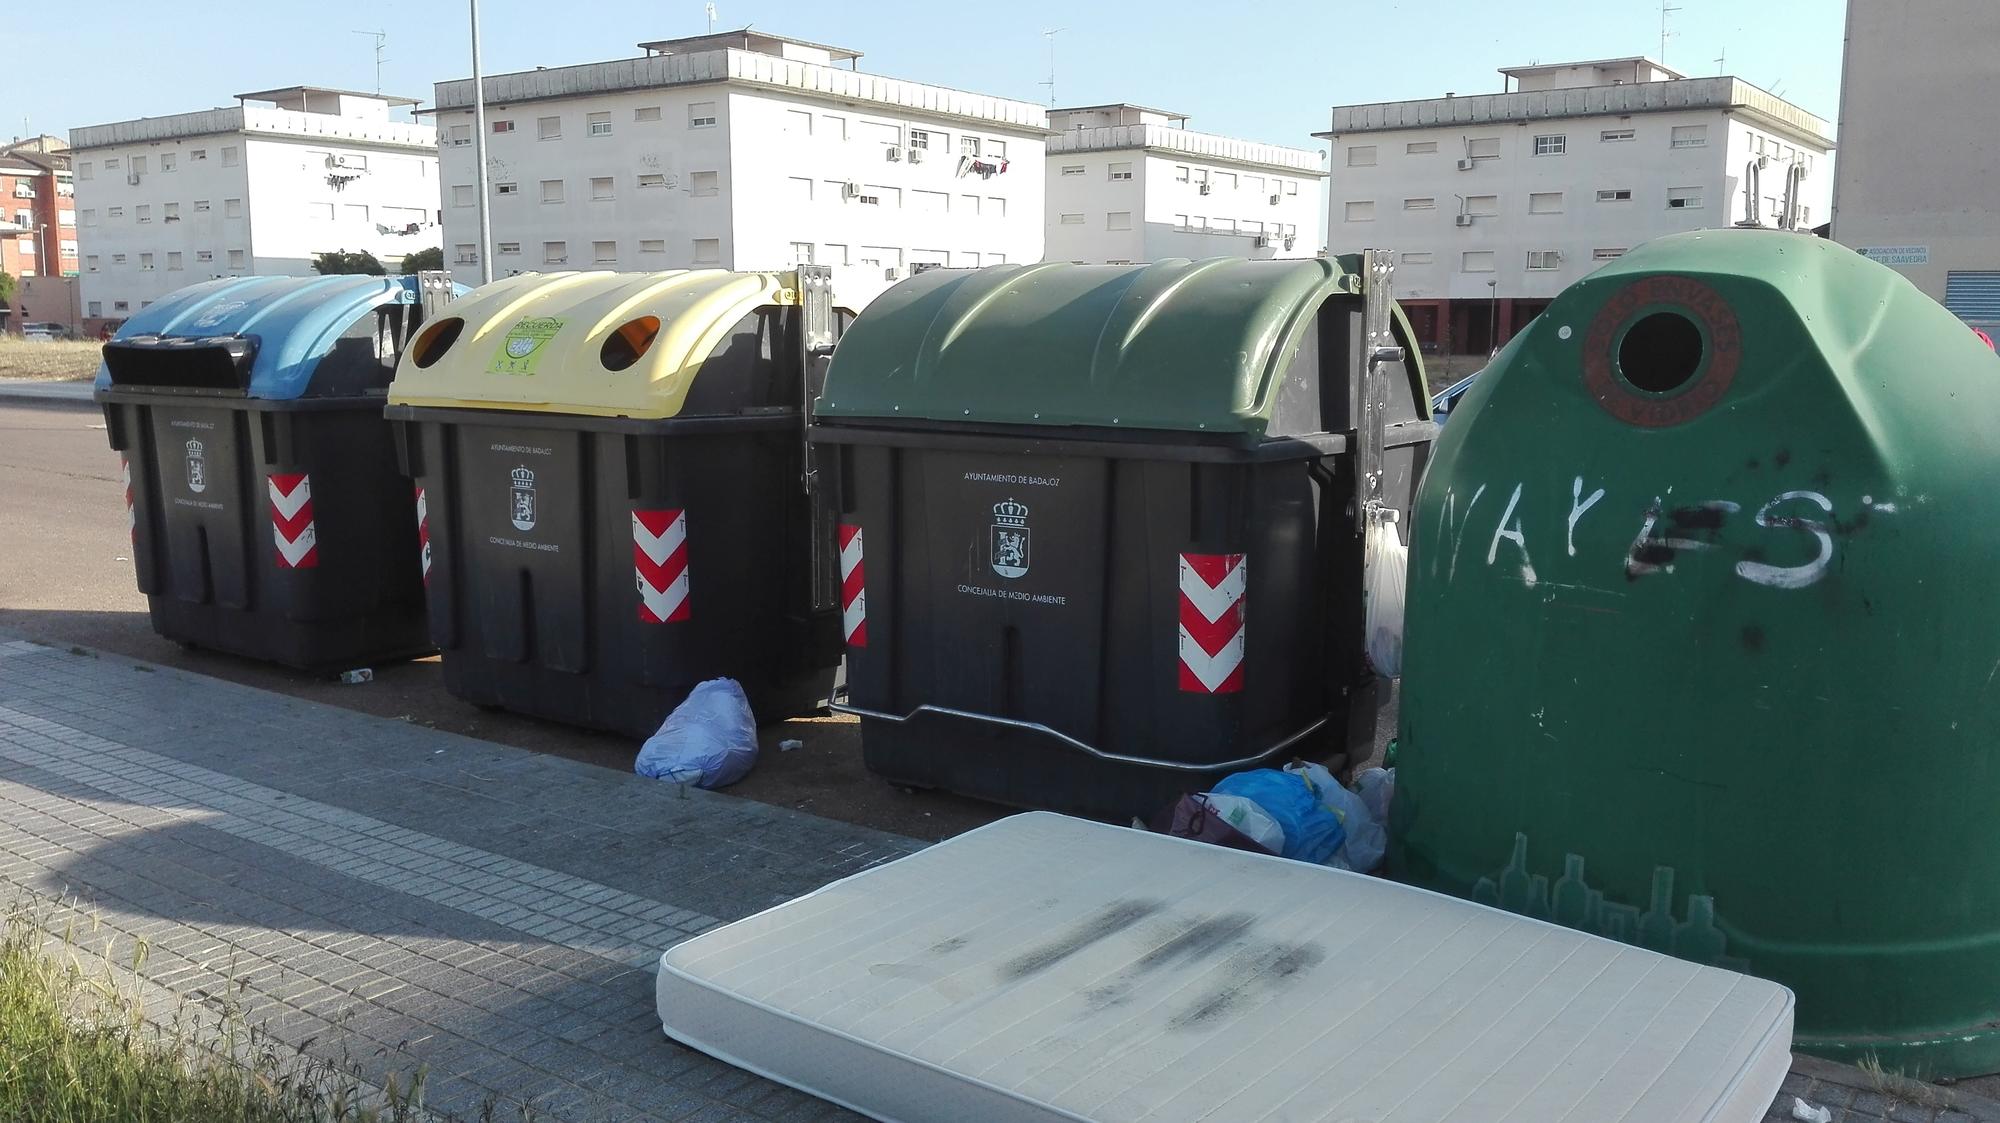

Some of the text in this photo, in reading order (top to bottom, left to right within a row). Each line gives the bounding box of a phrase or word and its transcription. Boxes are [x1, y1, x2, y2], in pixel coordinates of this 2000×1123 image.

[1892, 256, 1928, 264] SAAVEDRA
[964, 472, 1060, 487] AYUNTAMIENTO DE BADAJOZ
[998, 590, 1007, 598] DE
[1009, 591, 1031, 601] MEDIO
[1032, 594, 1066, 605] AMBIENTE
